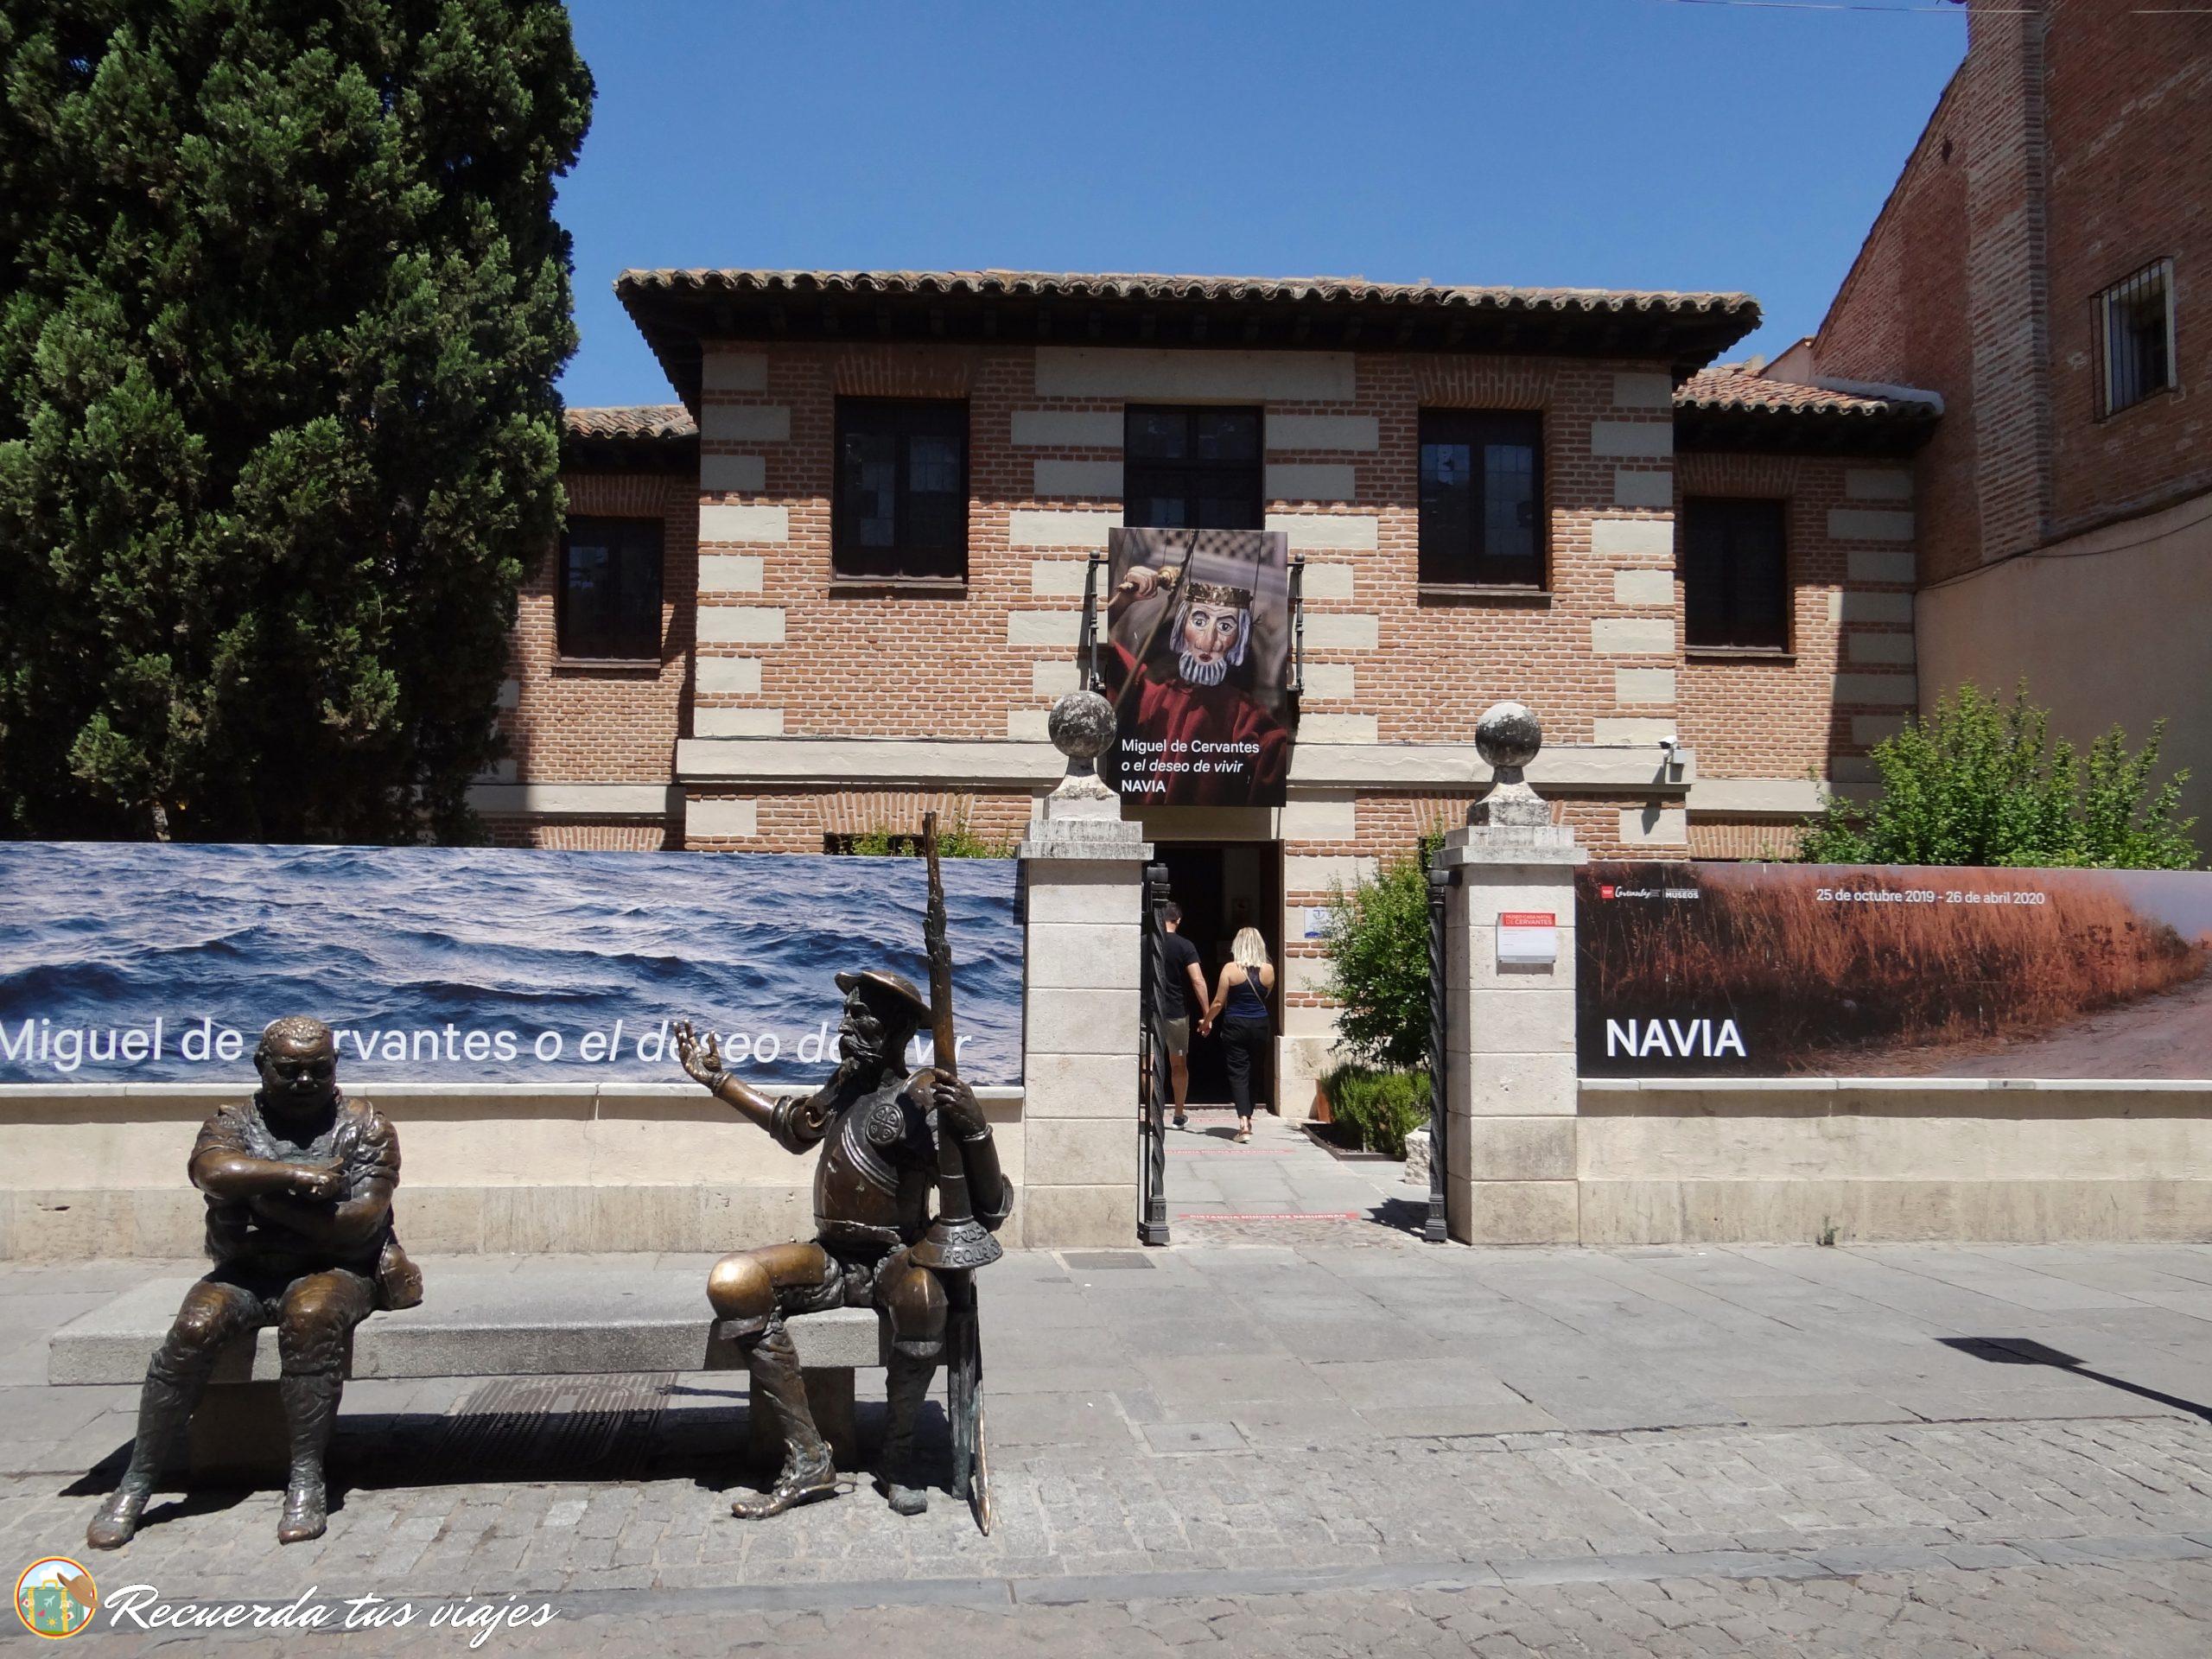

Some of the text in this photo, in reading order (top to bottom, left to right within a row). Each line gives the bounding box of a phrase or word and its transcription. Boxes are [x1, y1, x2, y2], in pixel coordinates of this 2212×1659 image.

[1122, 739, 1260, 754] Miguel de Cervantes
[1122, 759, 1243, 773] o el deseo de vivir
[1122, 779, 1166, 792] NAVIA
[1816, 888, 1832, 901] 25
[1834, 889, 1852, 901] de
[1853, 889, 1903, 902] octubre
[1904, 891, 1936, 903] 2019
[1946, 891, 1961, 903] 26
[1964, 891, 1980, 903] de
[1983, 892, 2011, 904] abril
[2012, 892, 2045, 905] 2020
[0, 1017, 162, 1072] Miguel
[181, 1017, 243, 1061] de
[264, 1019, 518, 1061] rvantes
[535, 1031, 563, 1062] o
[580, 1020, 623, 1062] el
[1606, 1019, 1746, 1057] NAVIA
